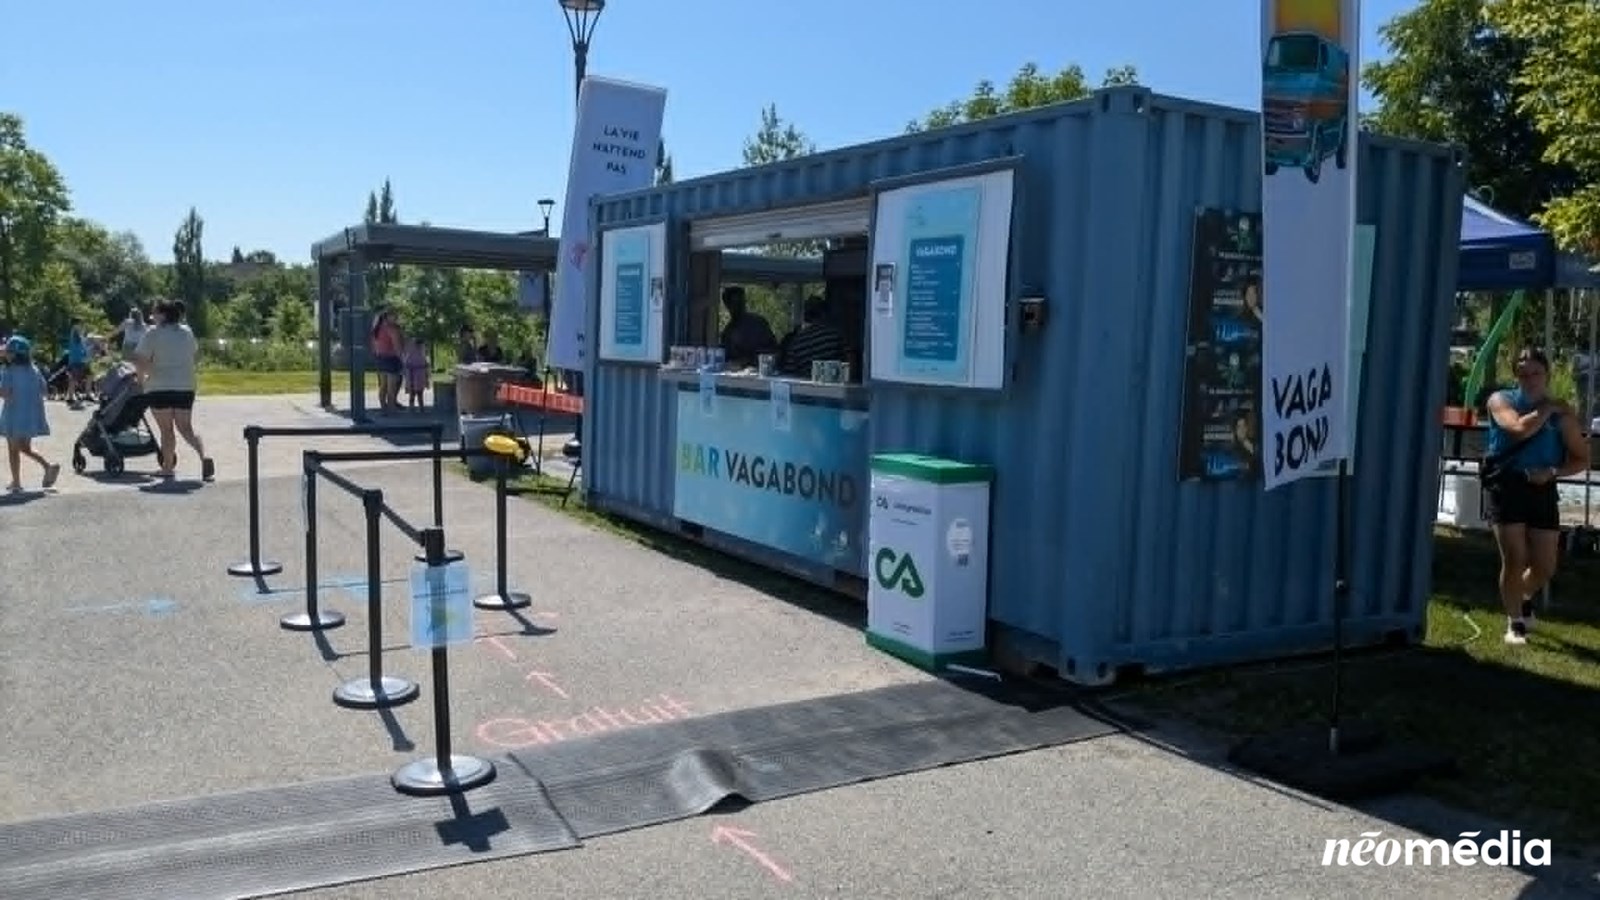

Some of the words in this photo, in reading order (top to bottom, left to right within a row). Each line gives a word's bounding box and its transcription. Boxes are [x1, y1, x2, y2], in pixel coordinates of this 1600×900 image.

[604, 125, 618, 138] LA
[606, 161, 626, 175] PAS
[1271, 362, 1332, 420] VAGA
[680, 442, 719, 479] BAR
[725, 450, 857, 508] VAGABOND
[1275, 415, 1329, 477] BOND
